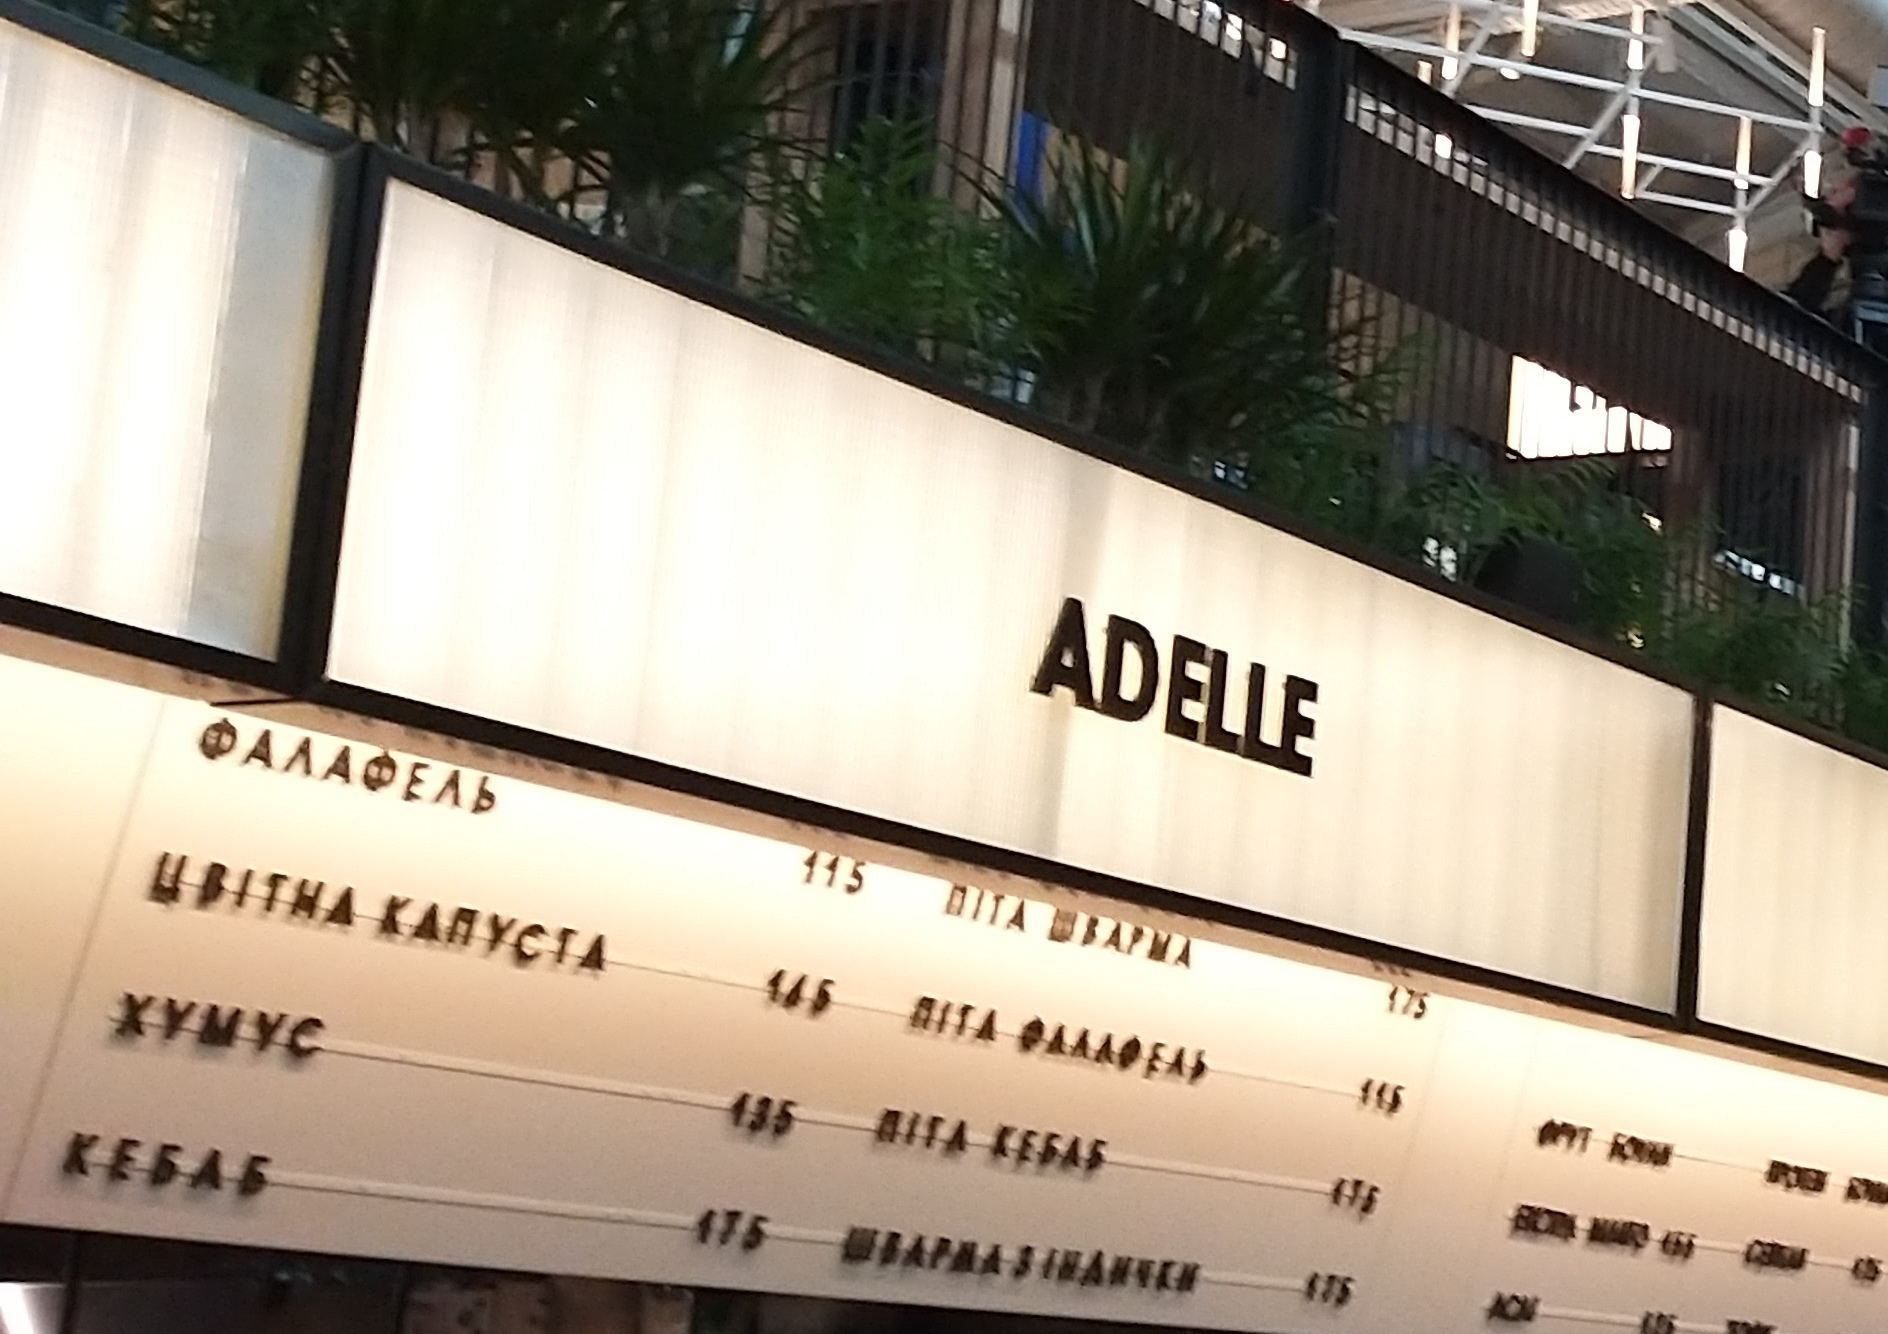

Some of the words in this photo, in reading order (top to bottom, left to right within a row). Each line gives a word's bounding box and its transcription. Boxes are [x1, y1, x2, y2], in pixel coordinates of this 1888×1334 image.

[1029, 597, 1319, 778] ADELLE
[199, 717, 497, 814] ФАЛАФЕЛЬ
[804, 851, 867, 894] 115
[151, 851, 355, 926] ЦВІТНА
[376, 894, 607, 971] КАПУСТА
[946, 885, 1025, 932] ПІТА
[1048, 907, 1192, 968] ШВАРМА
[114, 992, 326, 1058] ХУМУС
[910, 995, 997, 1041] ПІТА
[1018, 1015, 1209, 1086] ФАЛАФЕЛЬ
[874, 1108, 968, 1154] ПІТА
[993, 1122, 1108, 1174] КЕБАБ
[62, 1132, 272, 1197] КЕБАБ
[698, 1208, 770, 1253] 175
[841, 1225, 1002, 1275] ШВАРМА
